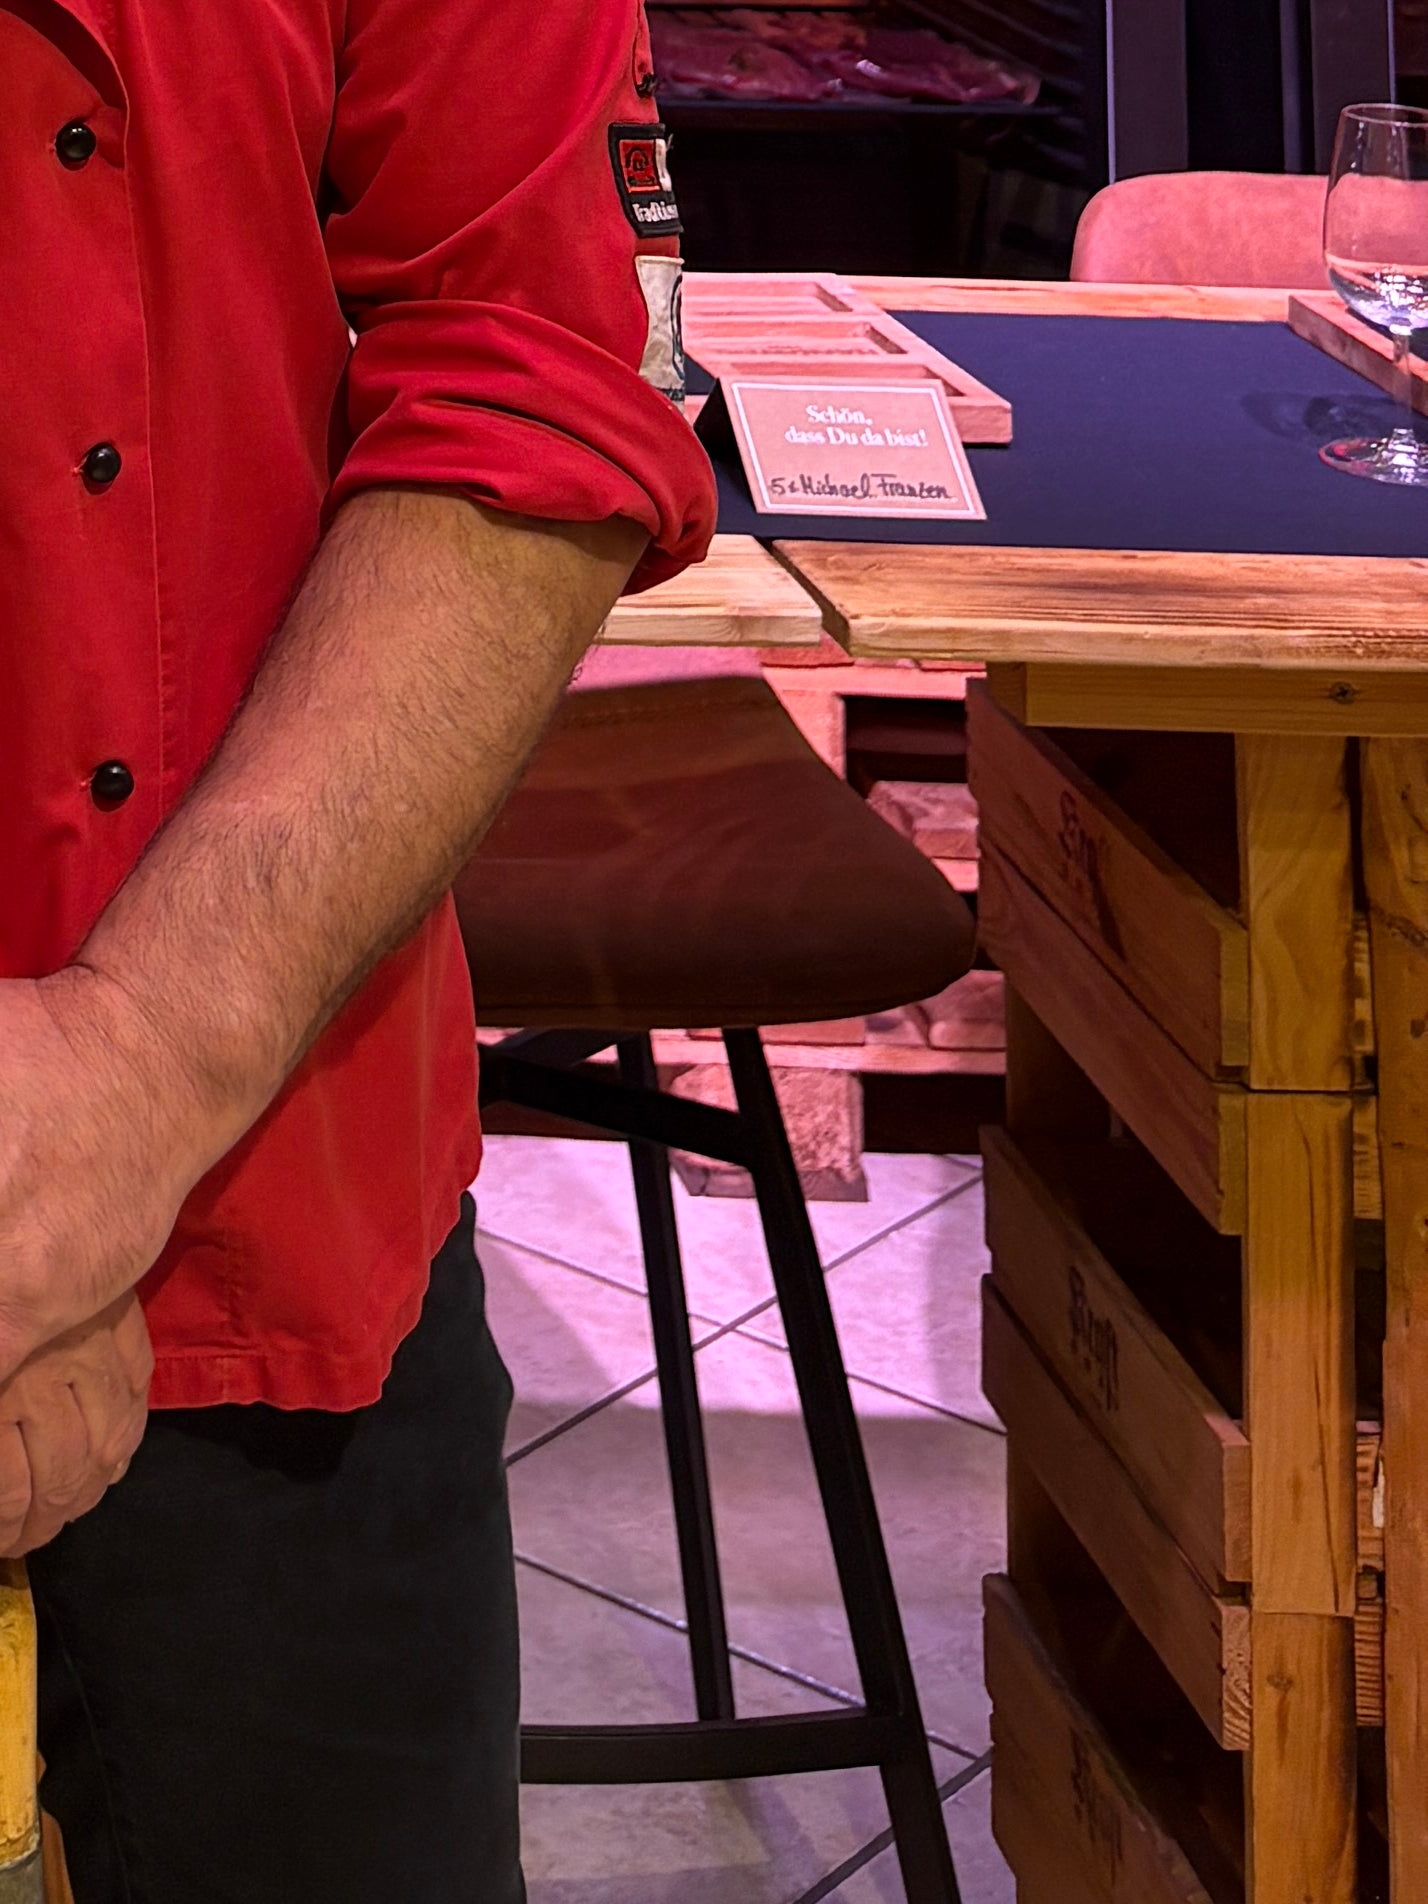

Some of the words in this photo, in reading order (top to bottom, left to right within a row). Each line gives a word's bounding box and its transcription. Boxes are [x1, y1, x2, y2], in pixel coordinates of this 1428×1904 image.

[784, 425, 826, 444] dass
[827, 426, 859, 446] Du
[860, 427, 885, 446] da
